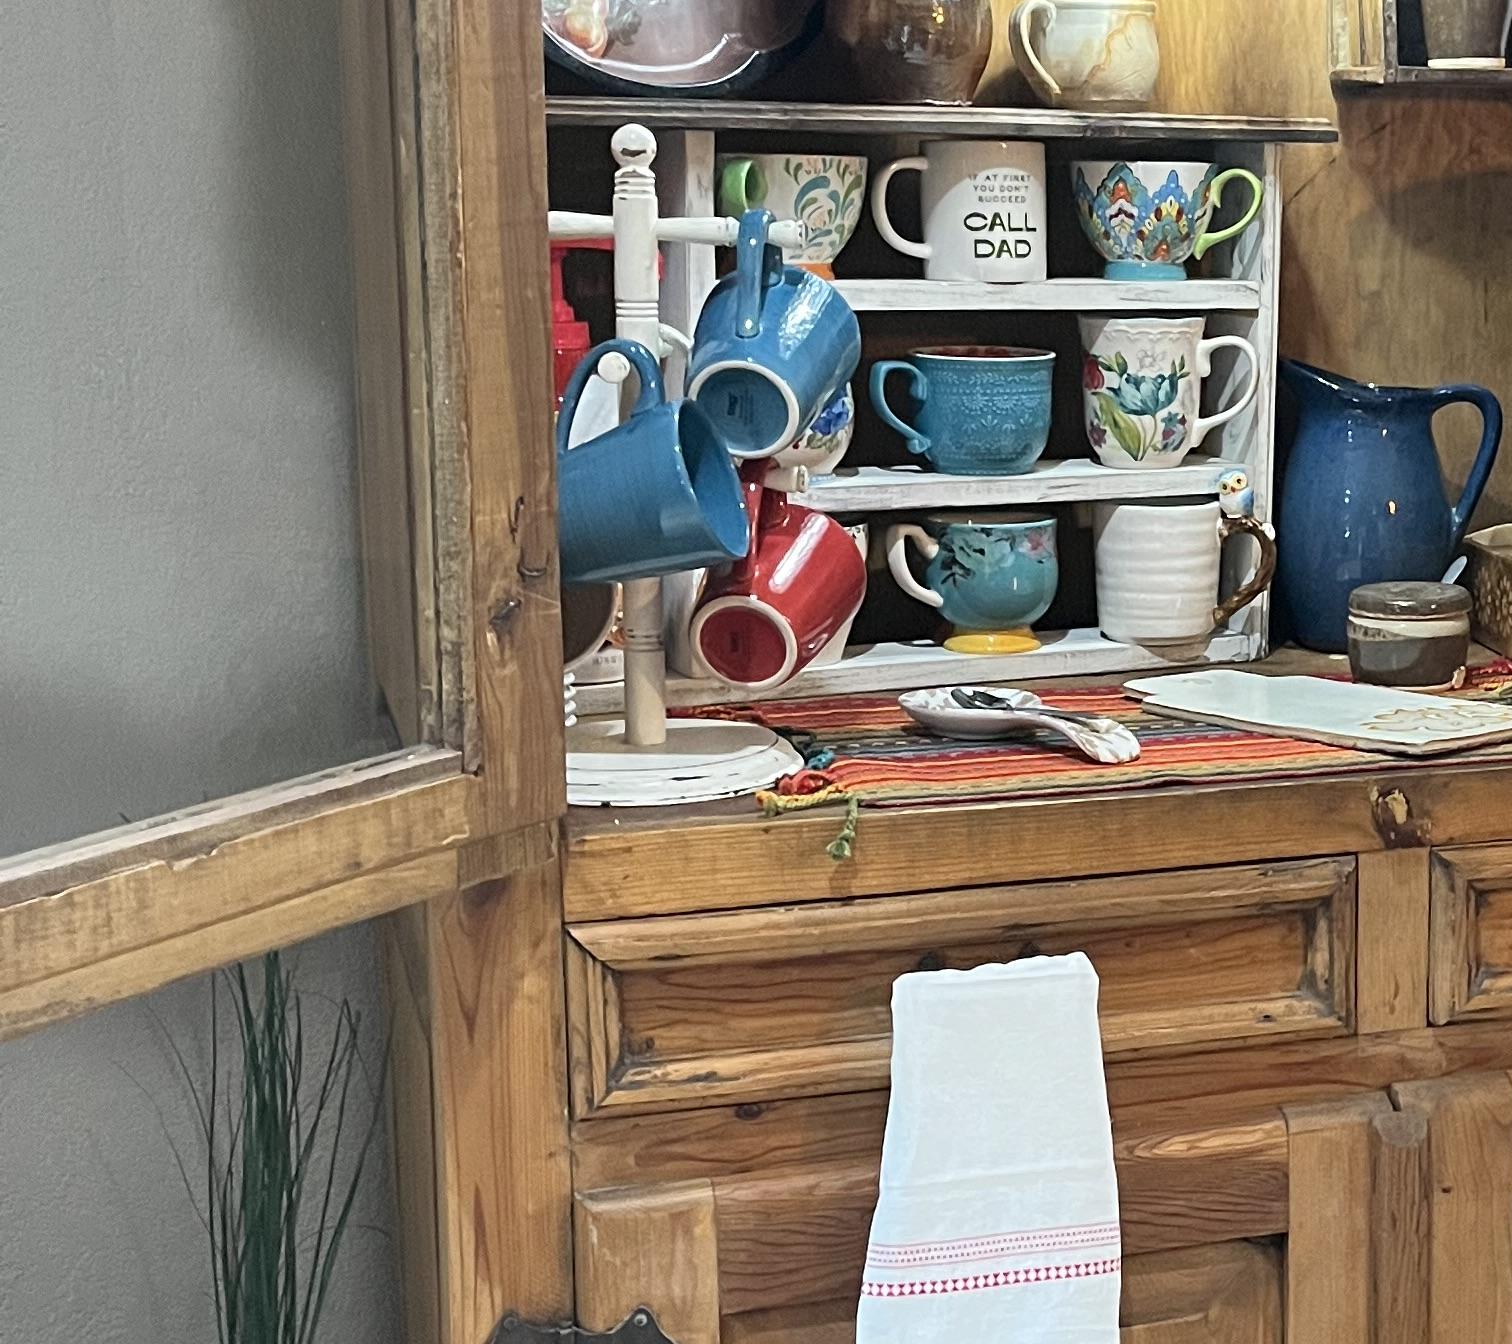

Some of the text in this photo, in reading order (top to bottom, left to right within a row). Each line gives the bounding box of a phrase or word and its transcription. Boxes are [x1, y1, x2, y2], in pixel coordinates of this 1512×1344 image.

[1003, 174, 1031, 182] FIRST
[978, 195, 1027, 203] SUCCEED
[963, 212, 1037, 232] CALL
[974, 239, 1032, 258] DAD
